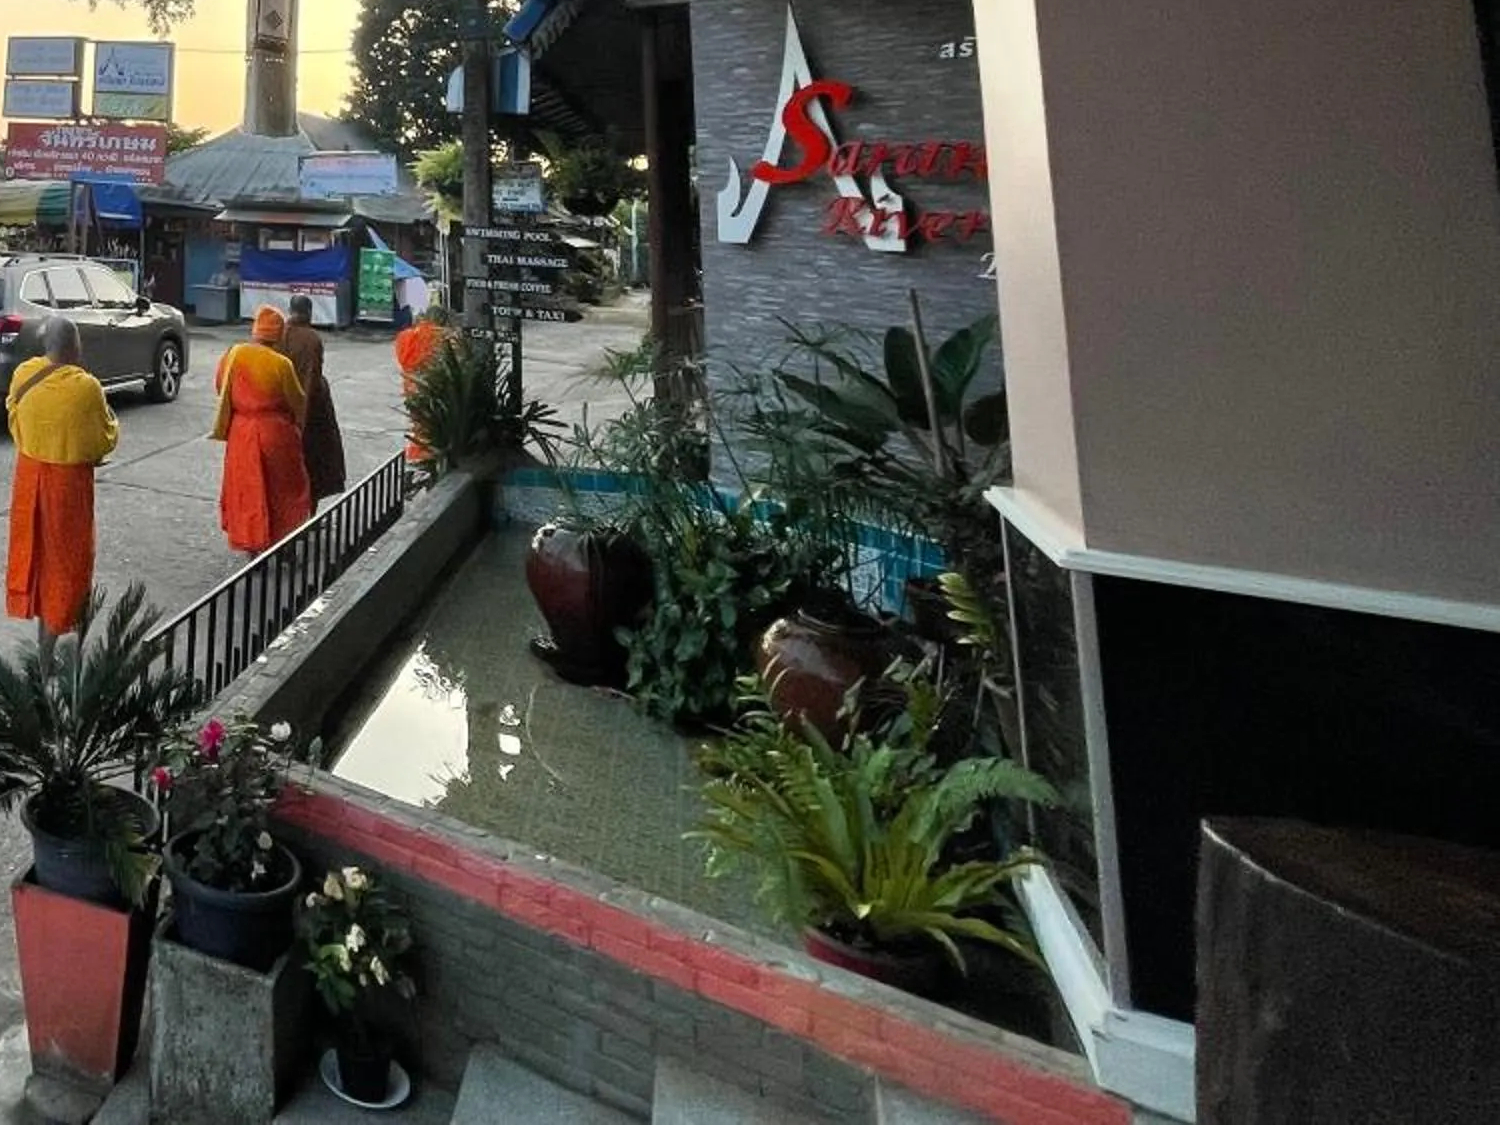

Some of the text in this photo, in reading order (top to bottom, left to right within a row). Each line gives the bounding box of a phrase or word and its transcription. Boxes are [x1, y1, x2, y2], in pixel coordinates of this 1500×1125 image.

[465, 227, 551, 242] SWIMMING POOL
[487, 254, 569, 268] THAI MASSAGE
[521, 282, 552, 294] COFFEE
[536, 309, 565, 322] TAXI
